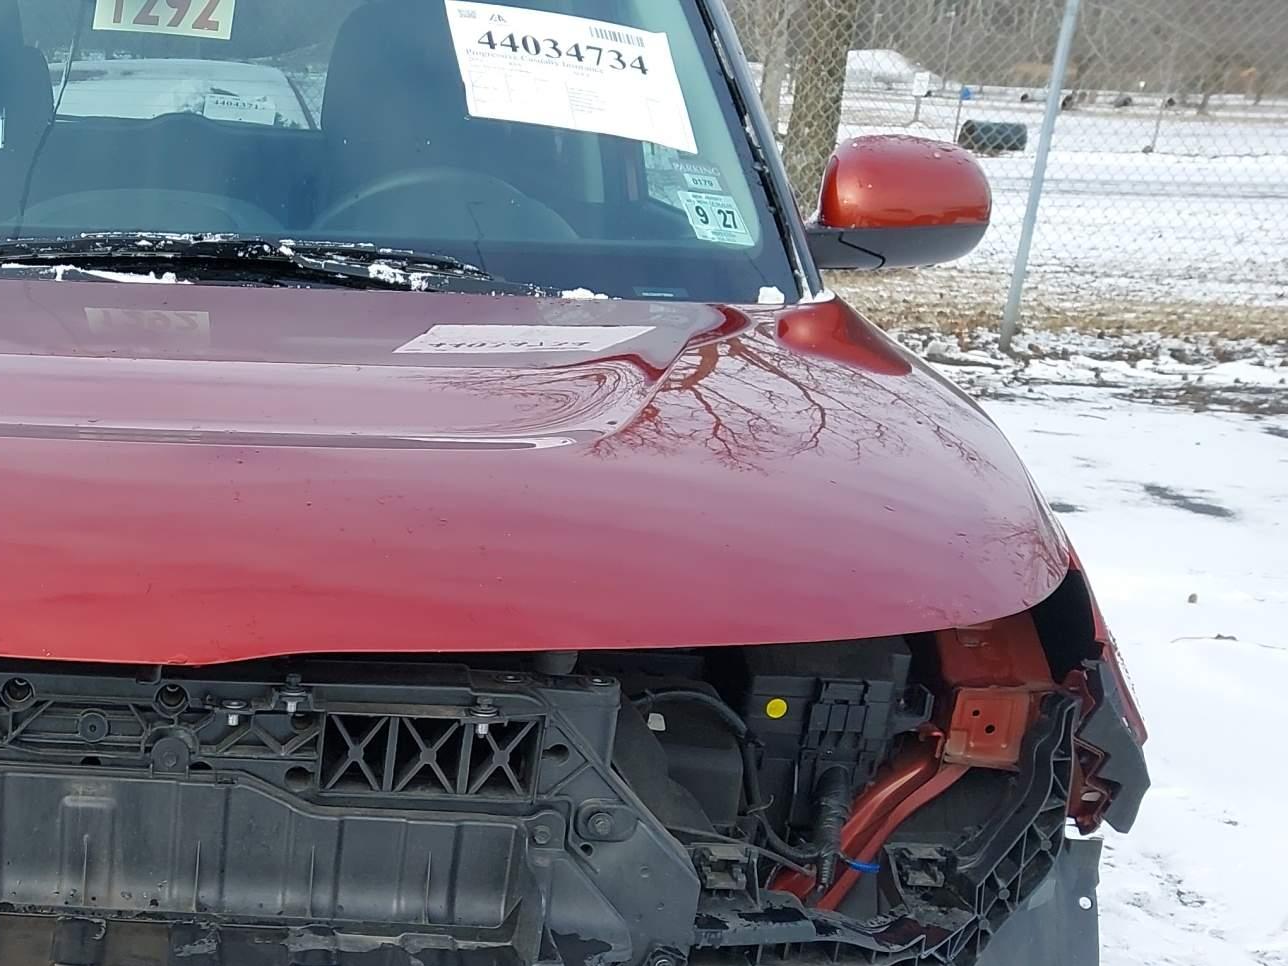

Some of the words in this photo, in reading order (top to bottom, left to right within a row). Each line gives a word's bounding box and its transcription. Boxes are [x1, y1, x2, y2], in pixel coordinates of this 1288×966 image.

[477, 30, 649, 75] 44034734
[695, 205, 710, 225] 9
[717, 208, 738, 229] 27
